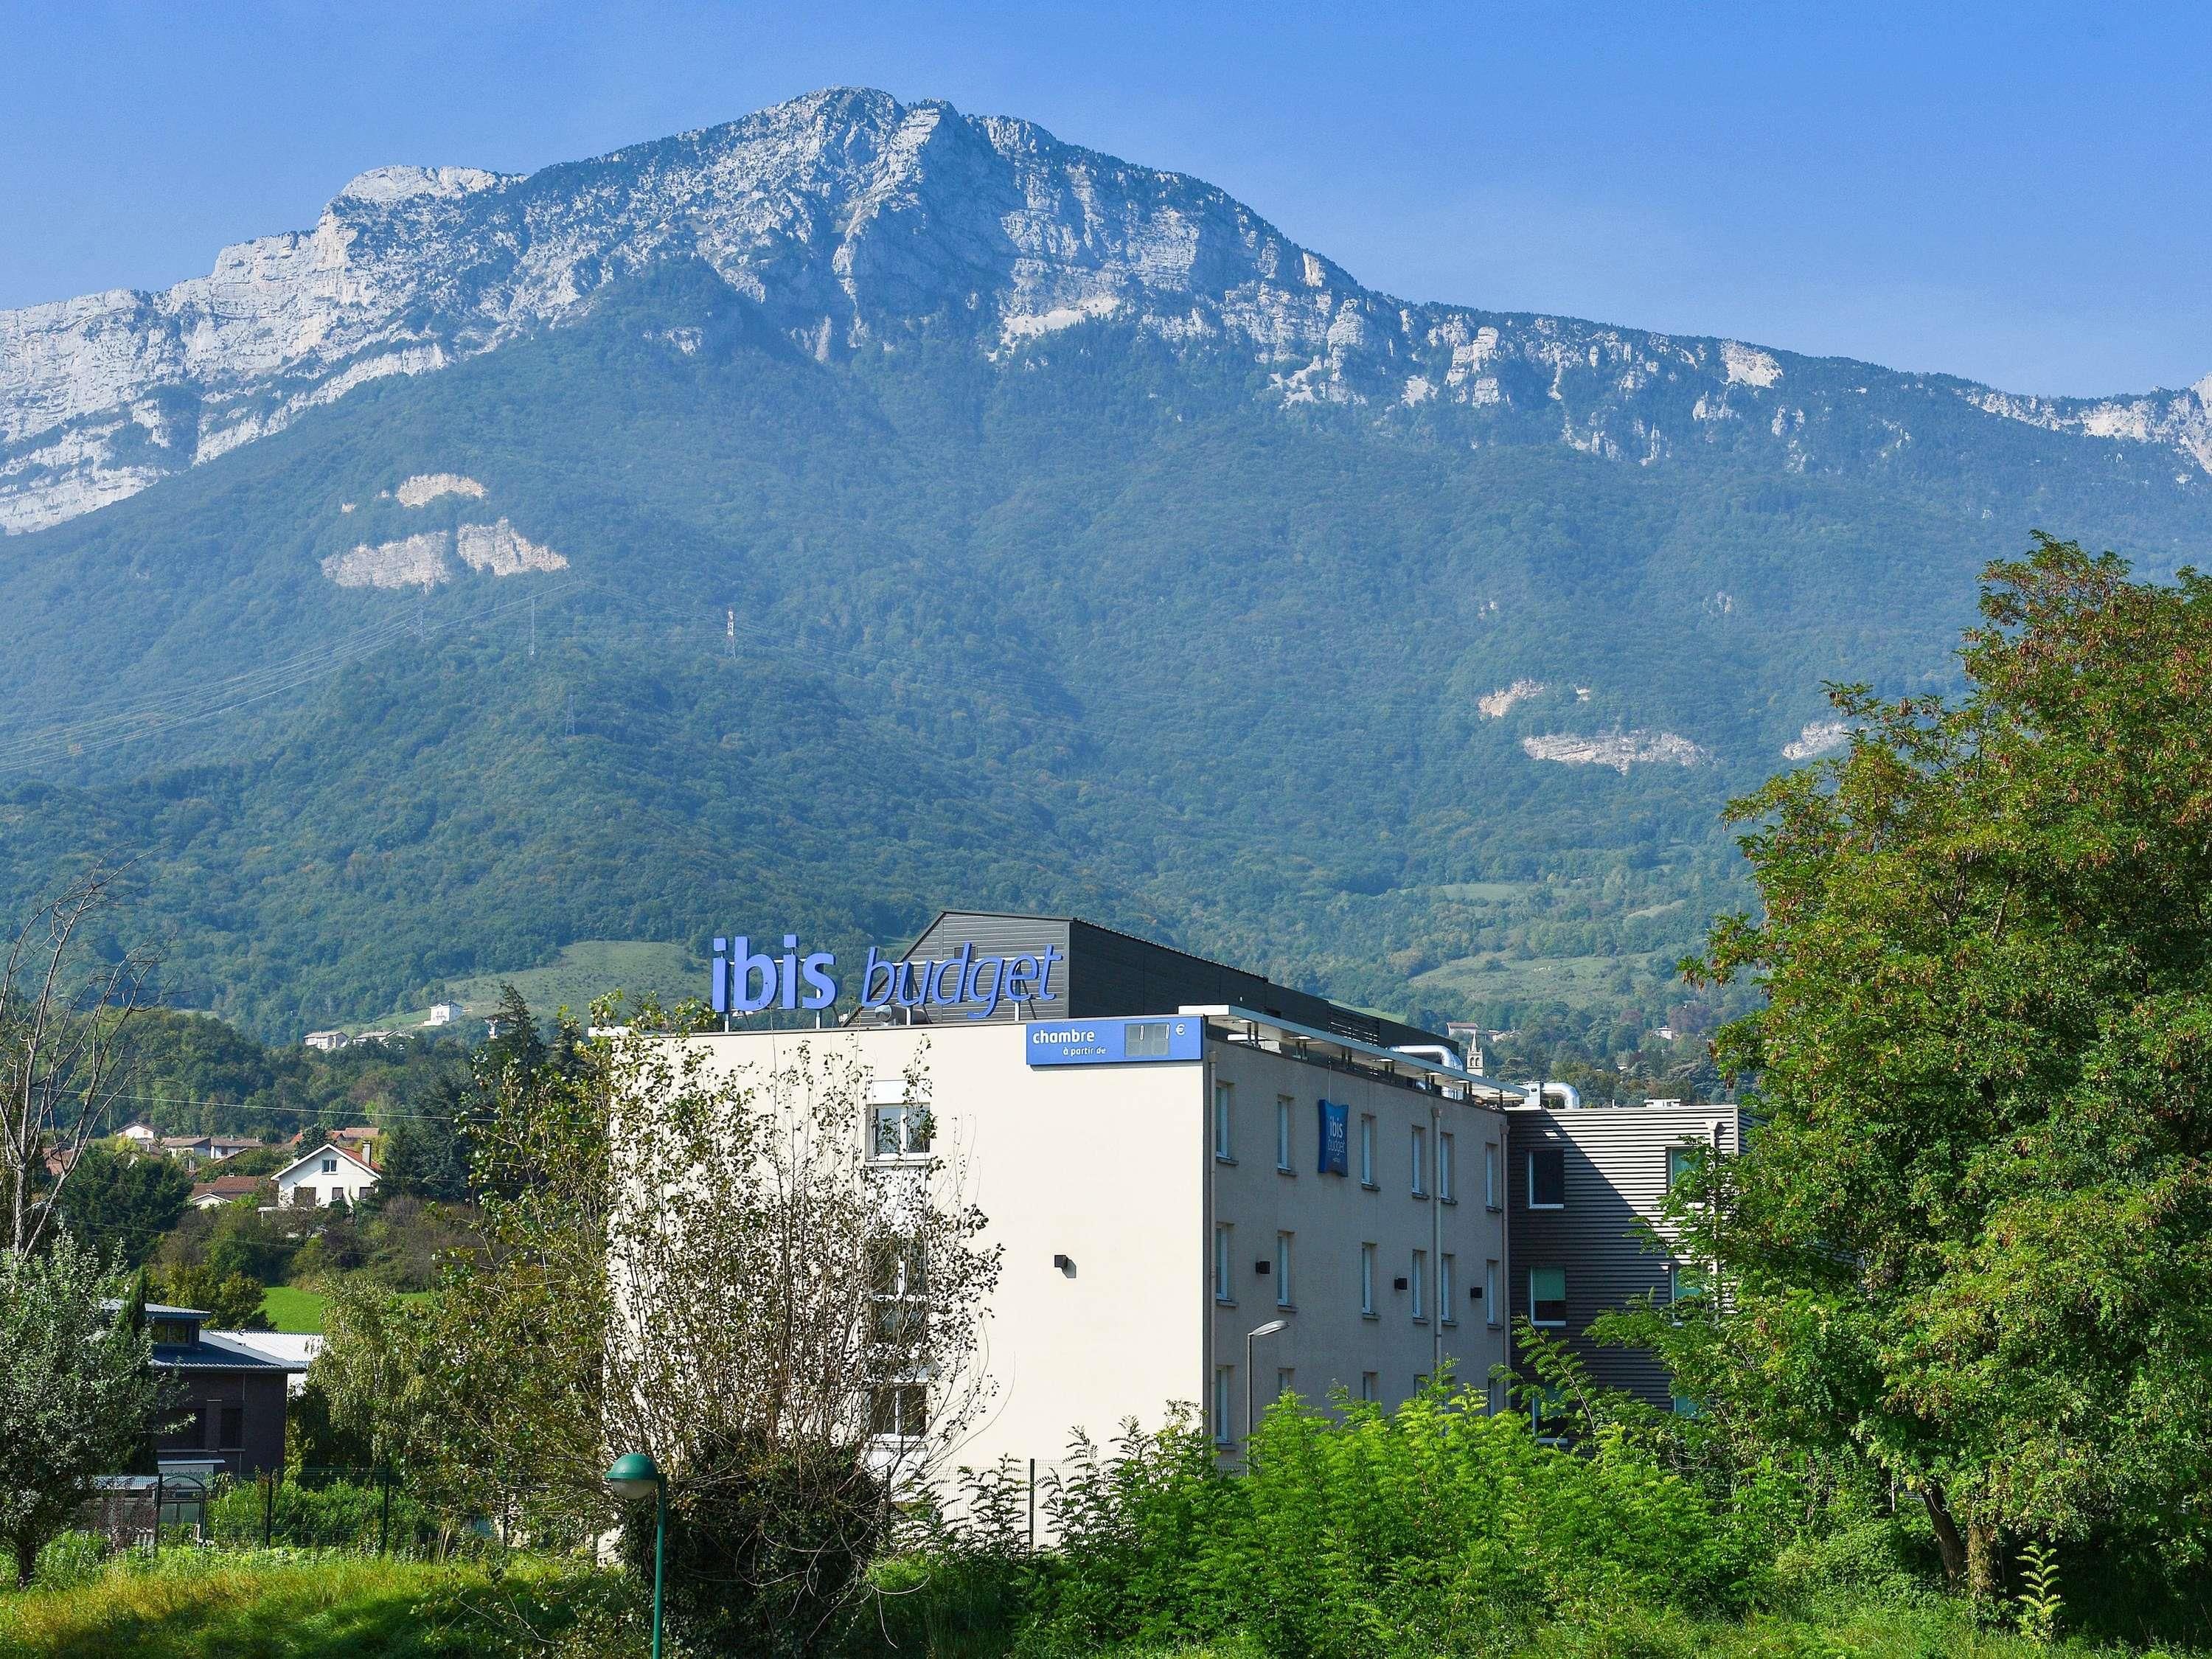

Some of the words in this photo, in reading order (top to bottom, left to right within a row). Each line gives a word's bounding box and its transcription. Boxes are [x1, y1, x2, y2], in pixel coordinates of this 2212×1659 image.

[712, 934, 838, 1012] ibis
[861, 942, 1063, 1019] budget
[1032, 1029, 1095, 1044] chambre
[1062, 1047, 1069, 1056] à
[1071, 1047, 1093, 1057] partir
[1329, 1116, 1343, 1138] ibis
